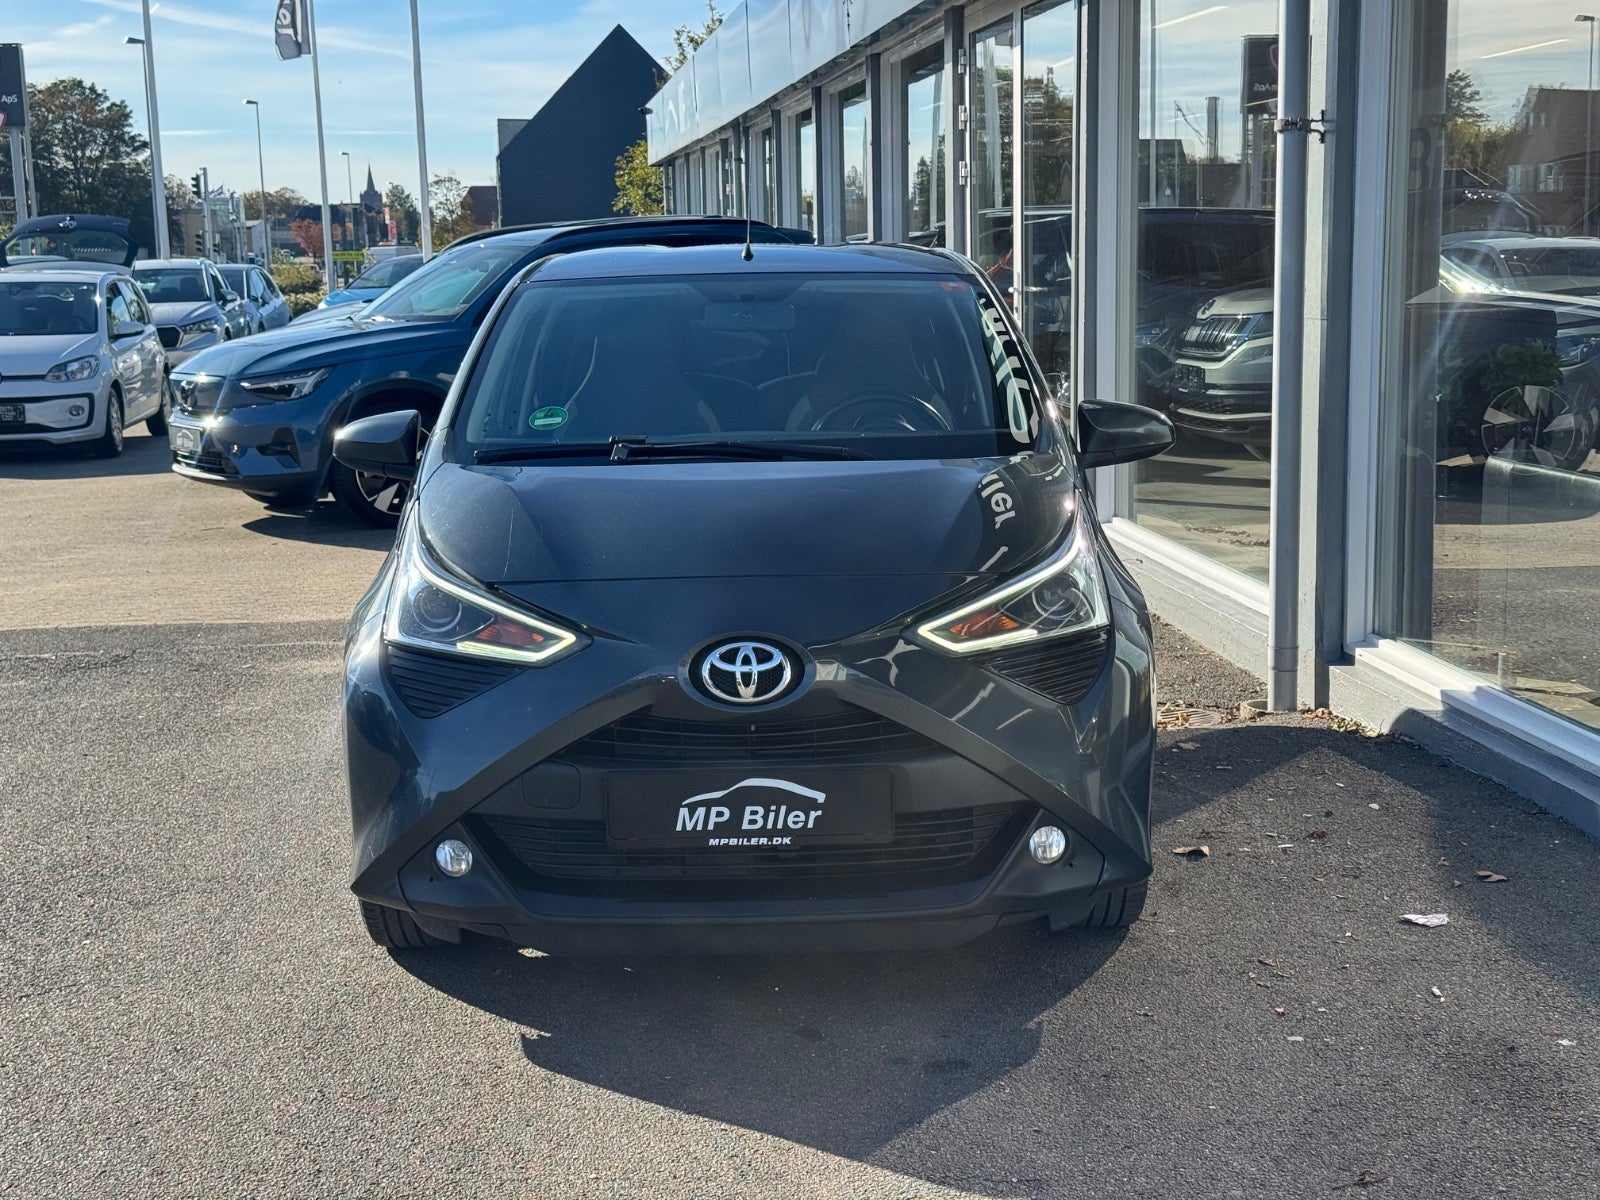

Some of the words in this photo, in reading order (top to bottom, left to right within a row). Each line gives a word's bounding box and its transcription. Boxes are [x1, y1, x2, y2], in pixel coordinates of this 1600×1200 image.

[1, 94, 18, 105] ApS
[675, 806, 731, 831] MP
[741, 805, 823, 830] Biler
[708, 836, 792, 846] MPBILER.DK
